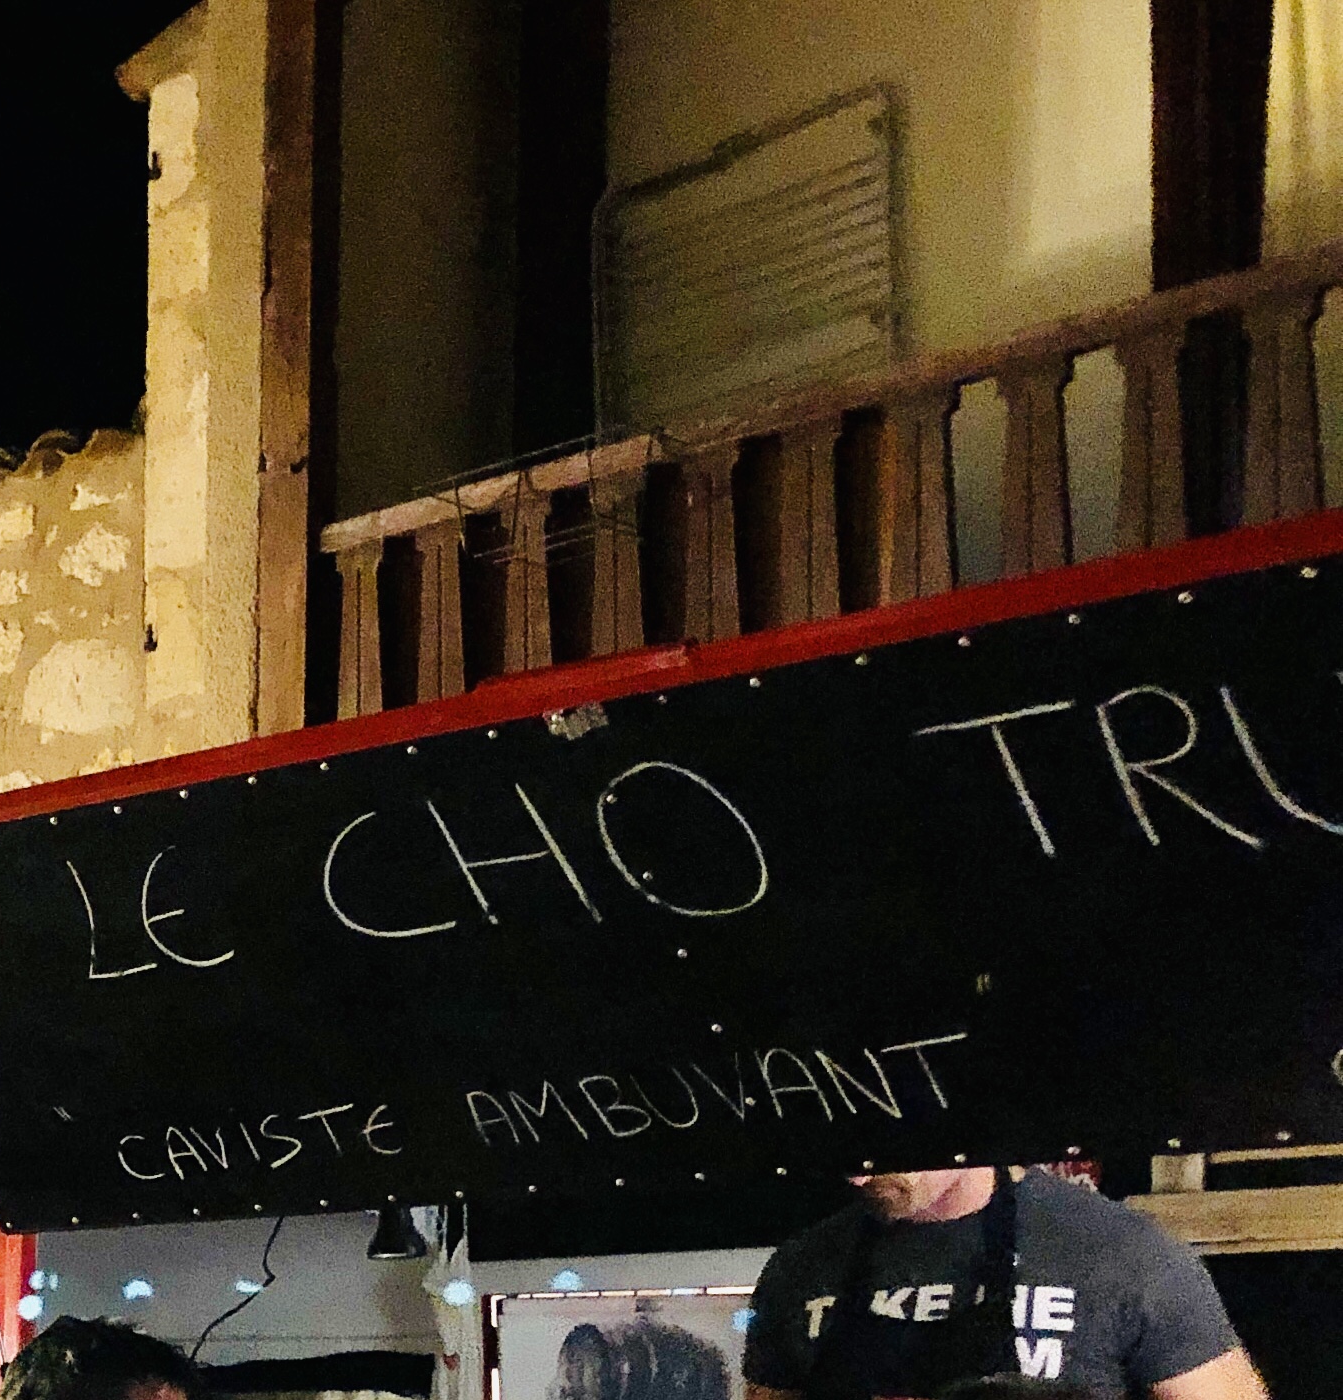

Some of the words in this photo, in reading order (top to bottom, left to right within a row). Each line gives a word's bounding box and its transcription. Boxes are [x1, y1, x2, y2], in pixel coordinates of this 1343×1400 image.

[65, 845, 235, 981] LE
[322, 760, 769, 938] CHO
[117, 1102, 403, 1181] CAVISTE
[466, 1031, 969, 1146] AMBUVANT
[804, 1284, 955, 1338] TKE
